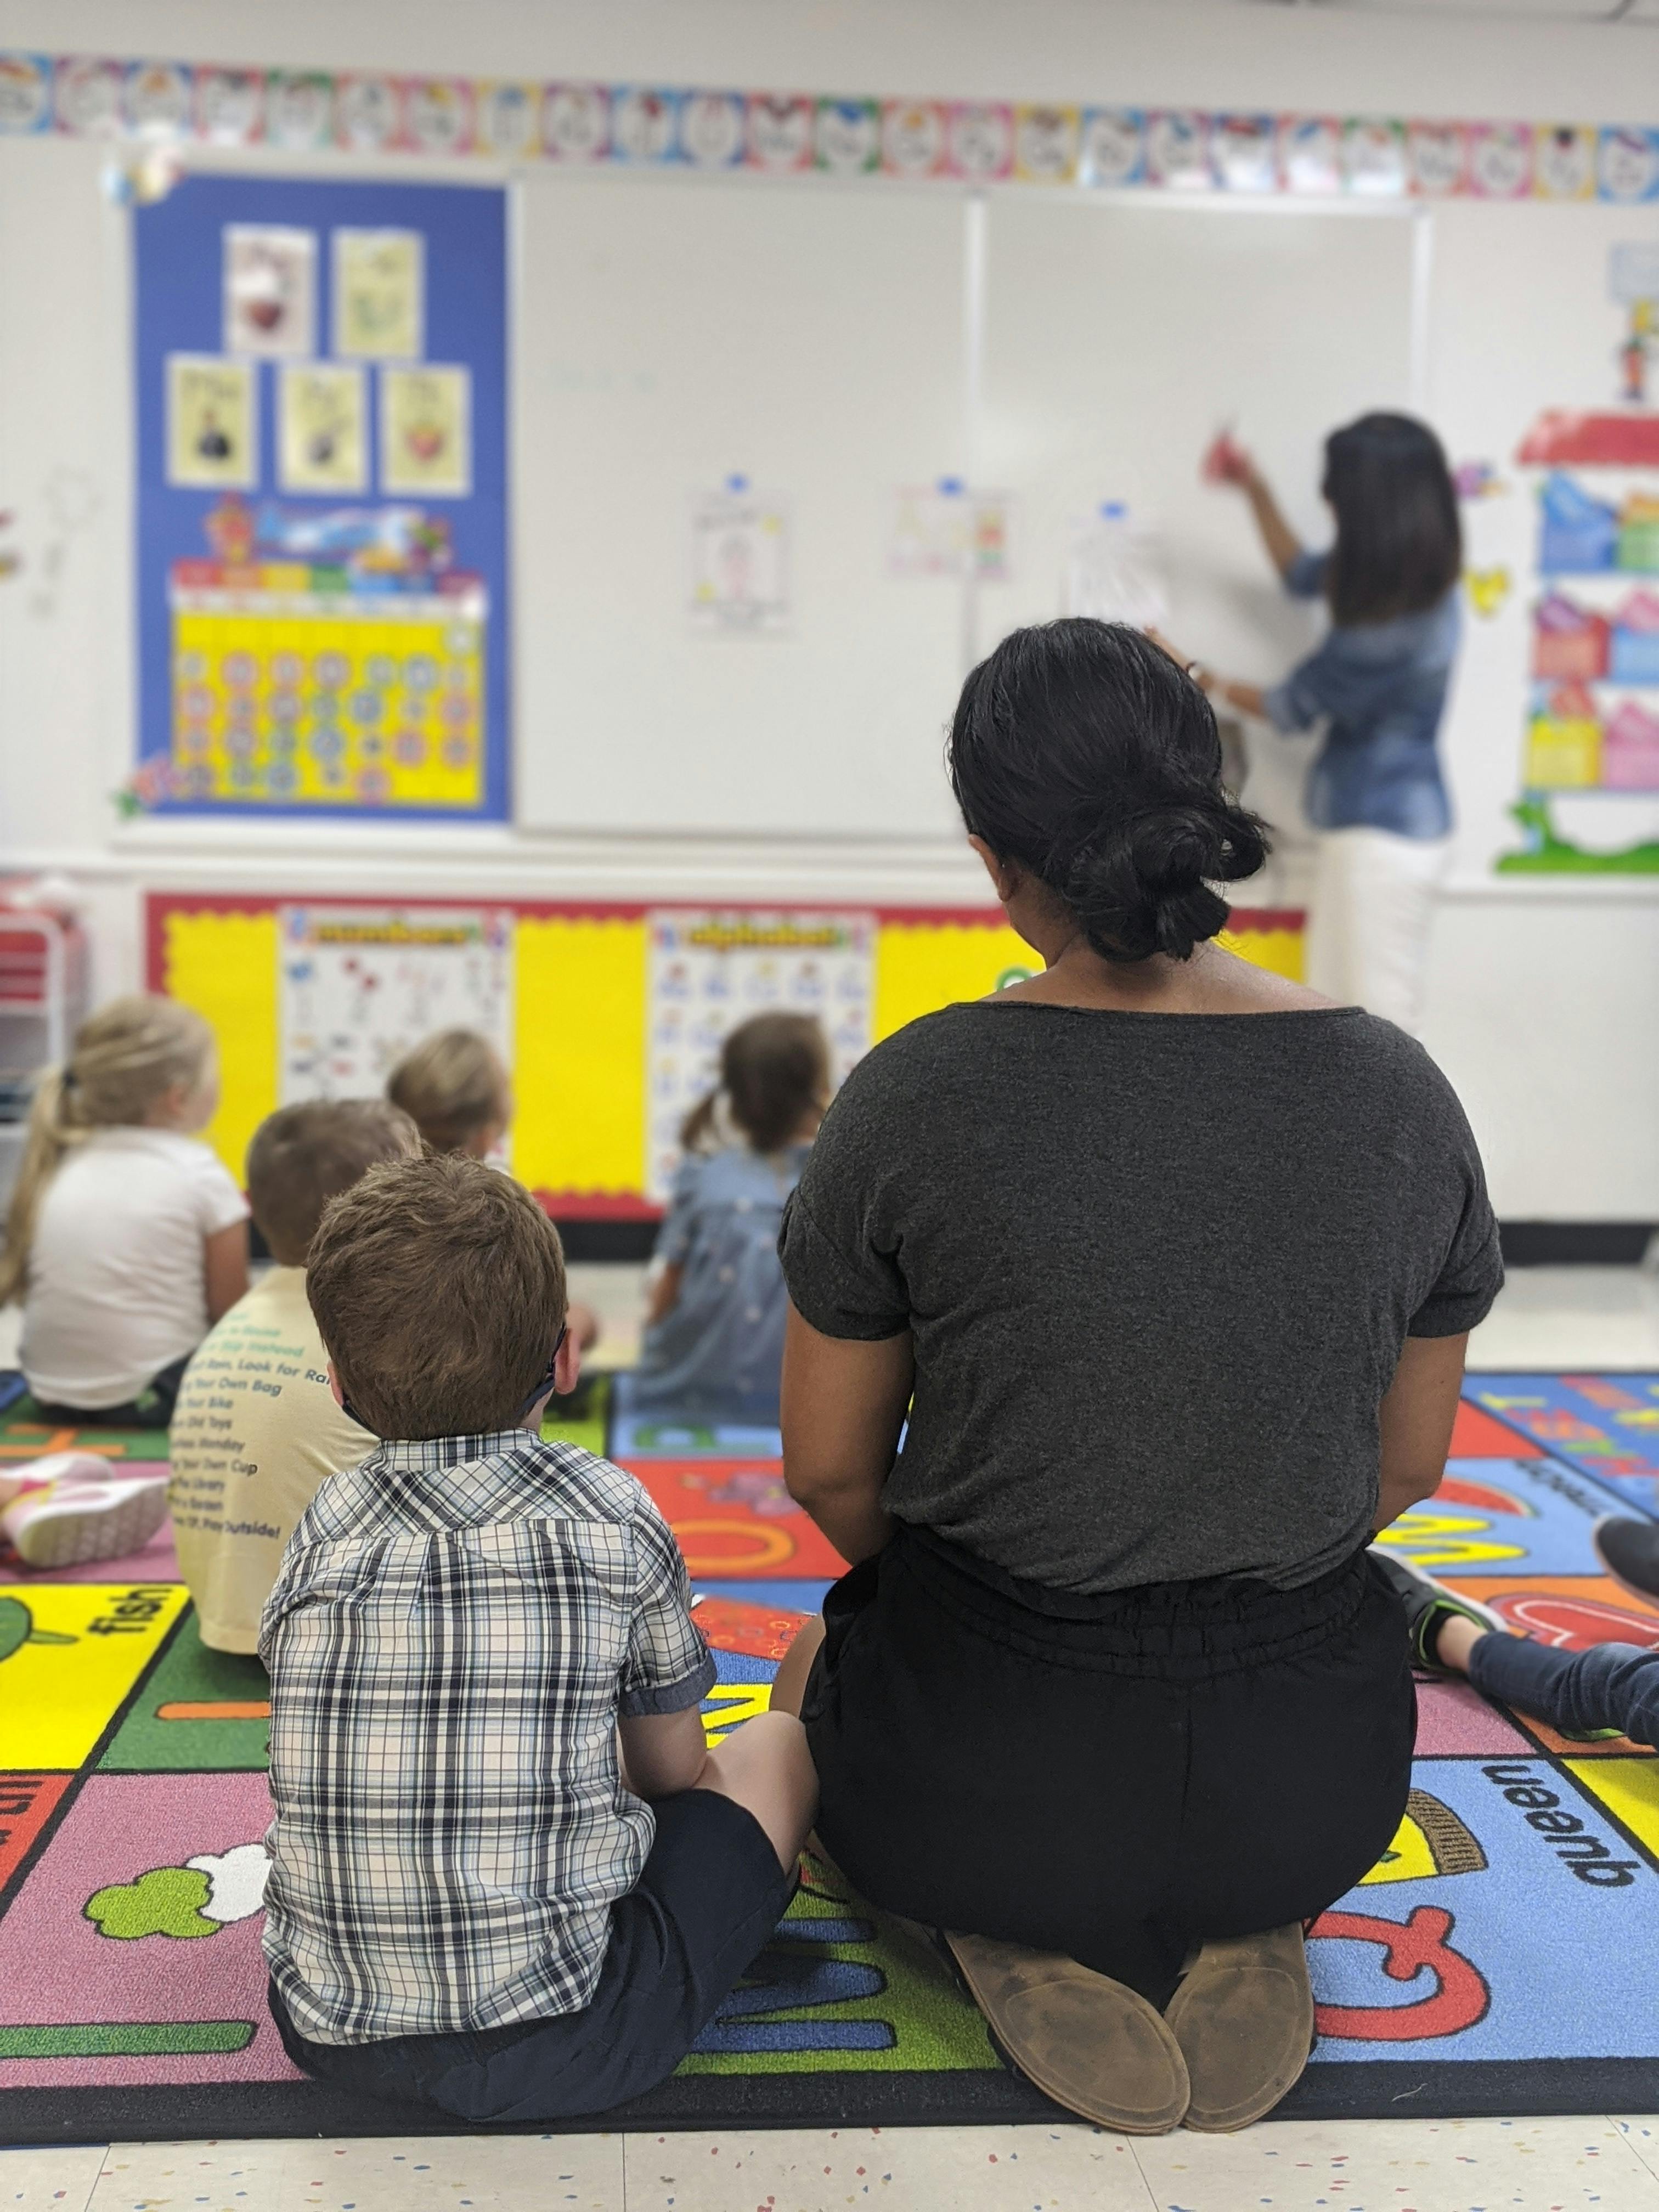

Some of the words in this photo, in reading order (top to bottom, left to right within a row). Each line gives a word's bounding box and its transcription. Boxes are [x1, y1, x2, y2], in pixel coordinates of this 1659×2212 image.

[238, 1358, 272, 1372] Look
[276, 1362, 301, 1377] for
[218, 1376, 247, 1389] Own
[252, 1379, 283, 1397] Bag
[231, 1458, 259, 1477] Cup
[87, 1587, 173, 1637] fish
[1481, 1764, 1640, 1888] queen
[1303, 1905, 1491, 2041] Q
